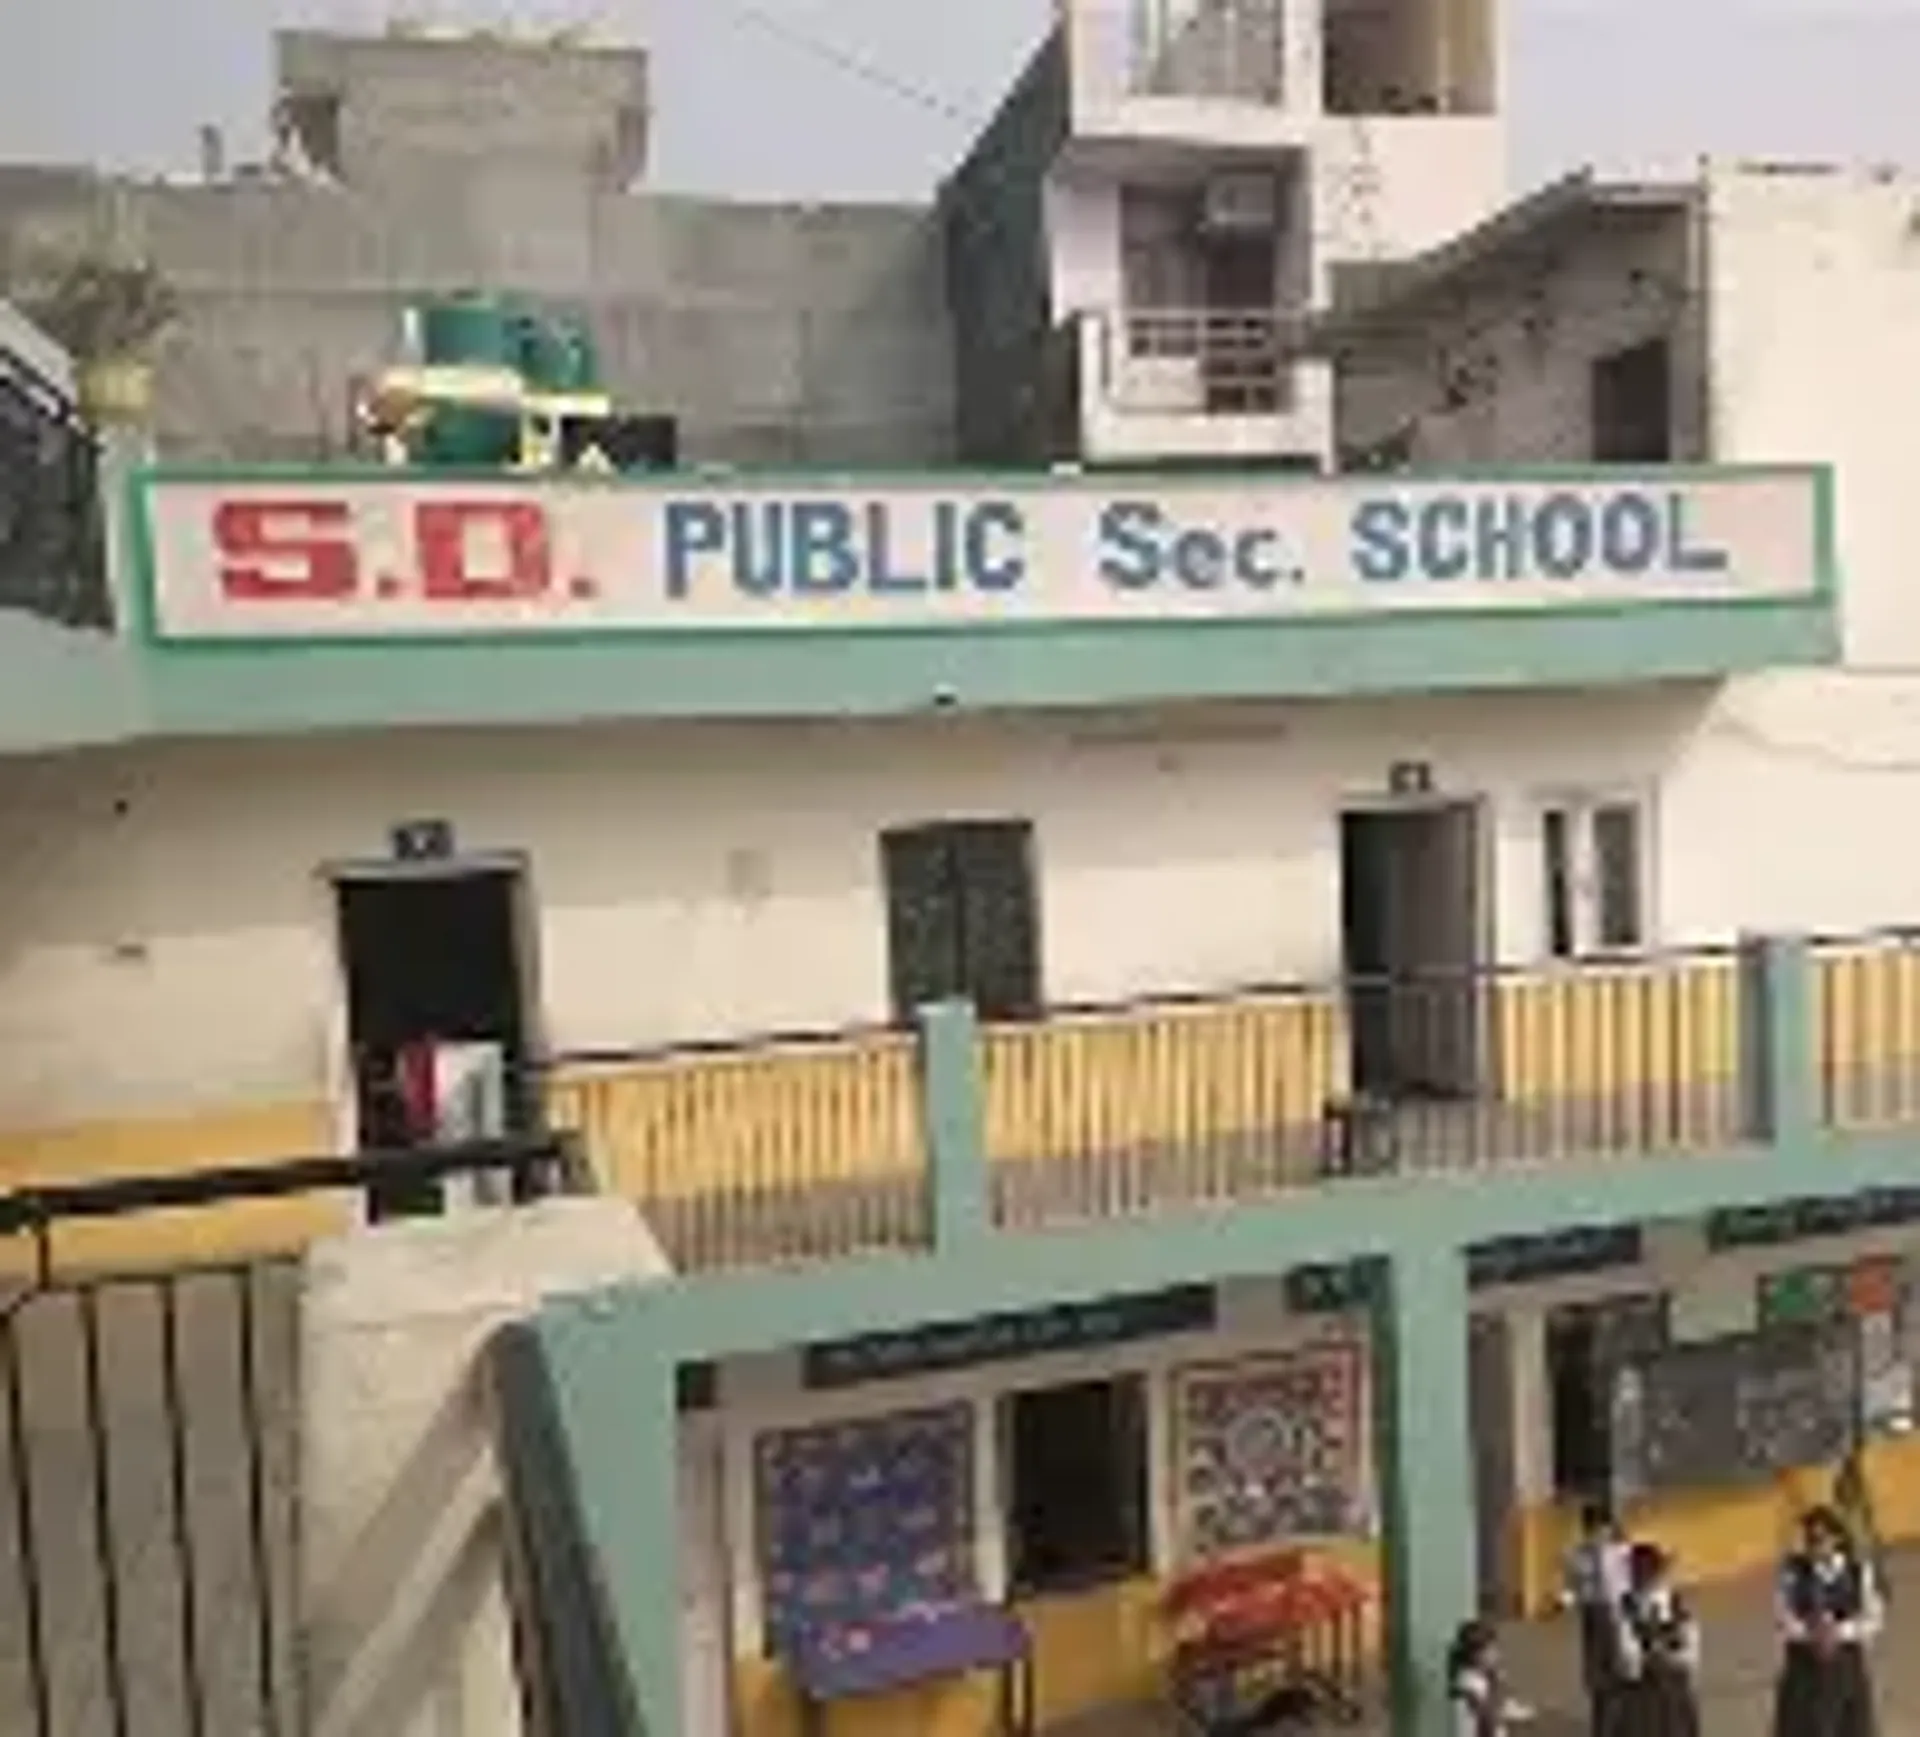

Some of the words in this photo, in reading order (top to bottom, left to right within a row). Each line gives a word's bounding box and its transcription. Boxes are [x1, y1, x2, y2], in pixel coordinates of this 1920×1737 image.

[212, 501, 596, 600] S.D.
[663, 500, 1025, 598] PUBLIC
[1098, 501, 1304, 589] Sec.
[1351, 491, 1728, 580] SCHOOL
